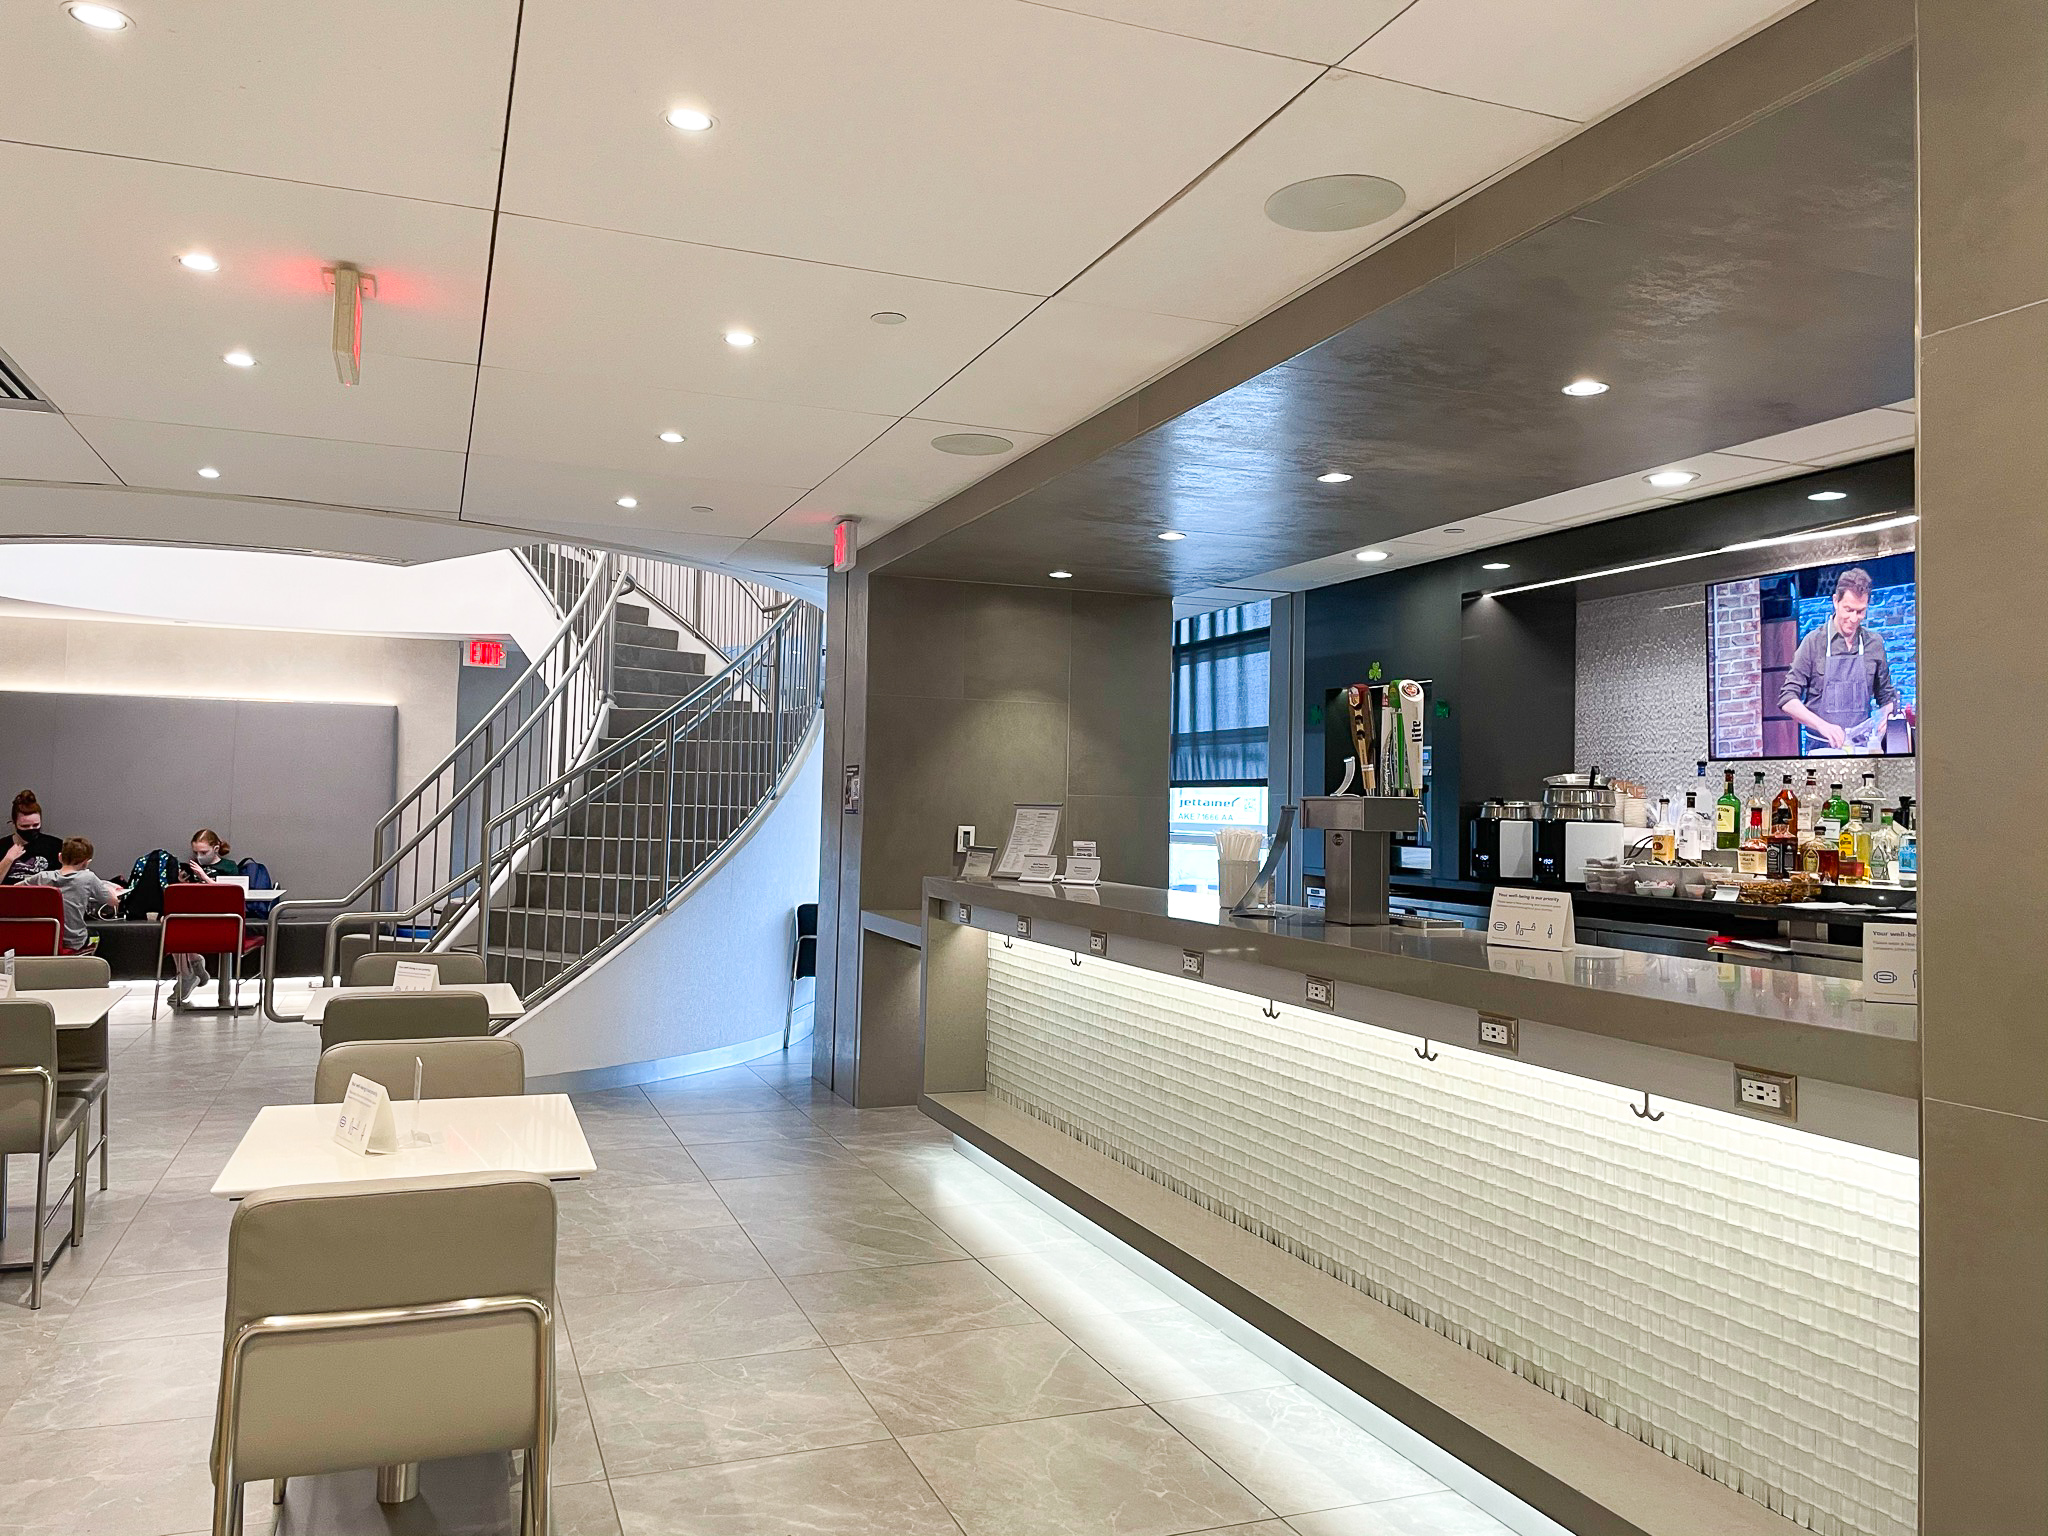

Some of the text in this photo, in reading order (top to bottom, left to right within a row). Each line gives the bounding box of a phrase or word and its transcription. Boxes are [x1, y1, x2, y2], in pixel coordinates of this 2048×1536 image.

[1411, 720, 1423, 743] lite
[1179, 796, 1241, 808] jettainer
[1178, 812, 1195, 821] AKE
